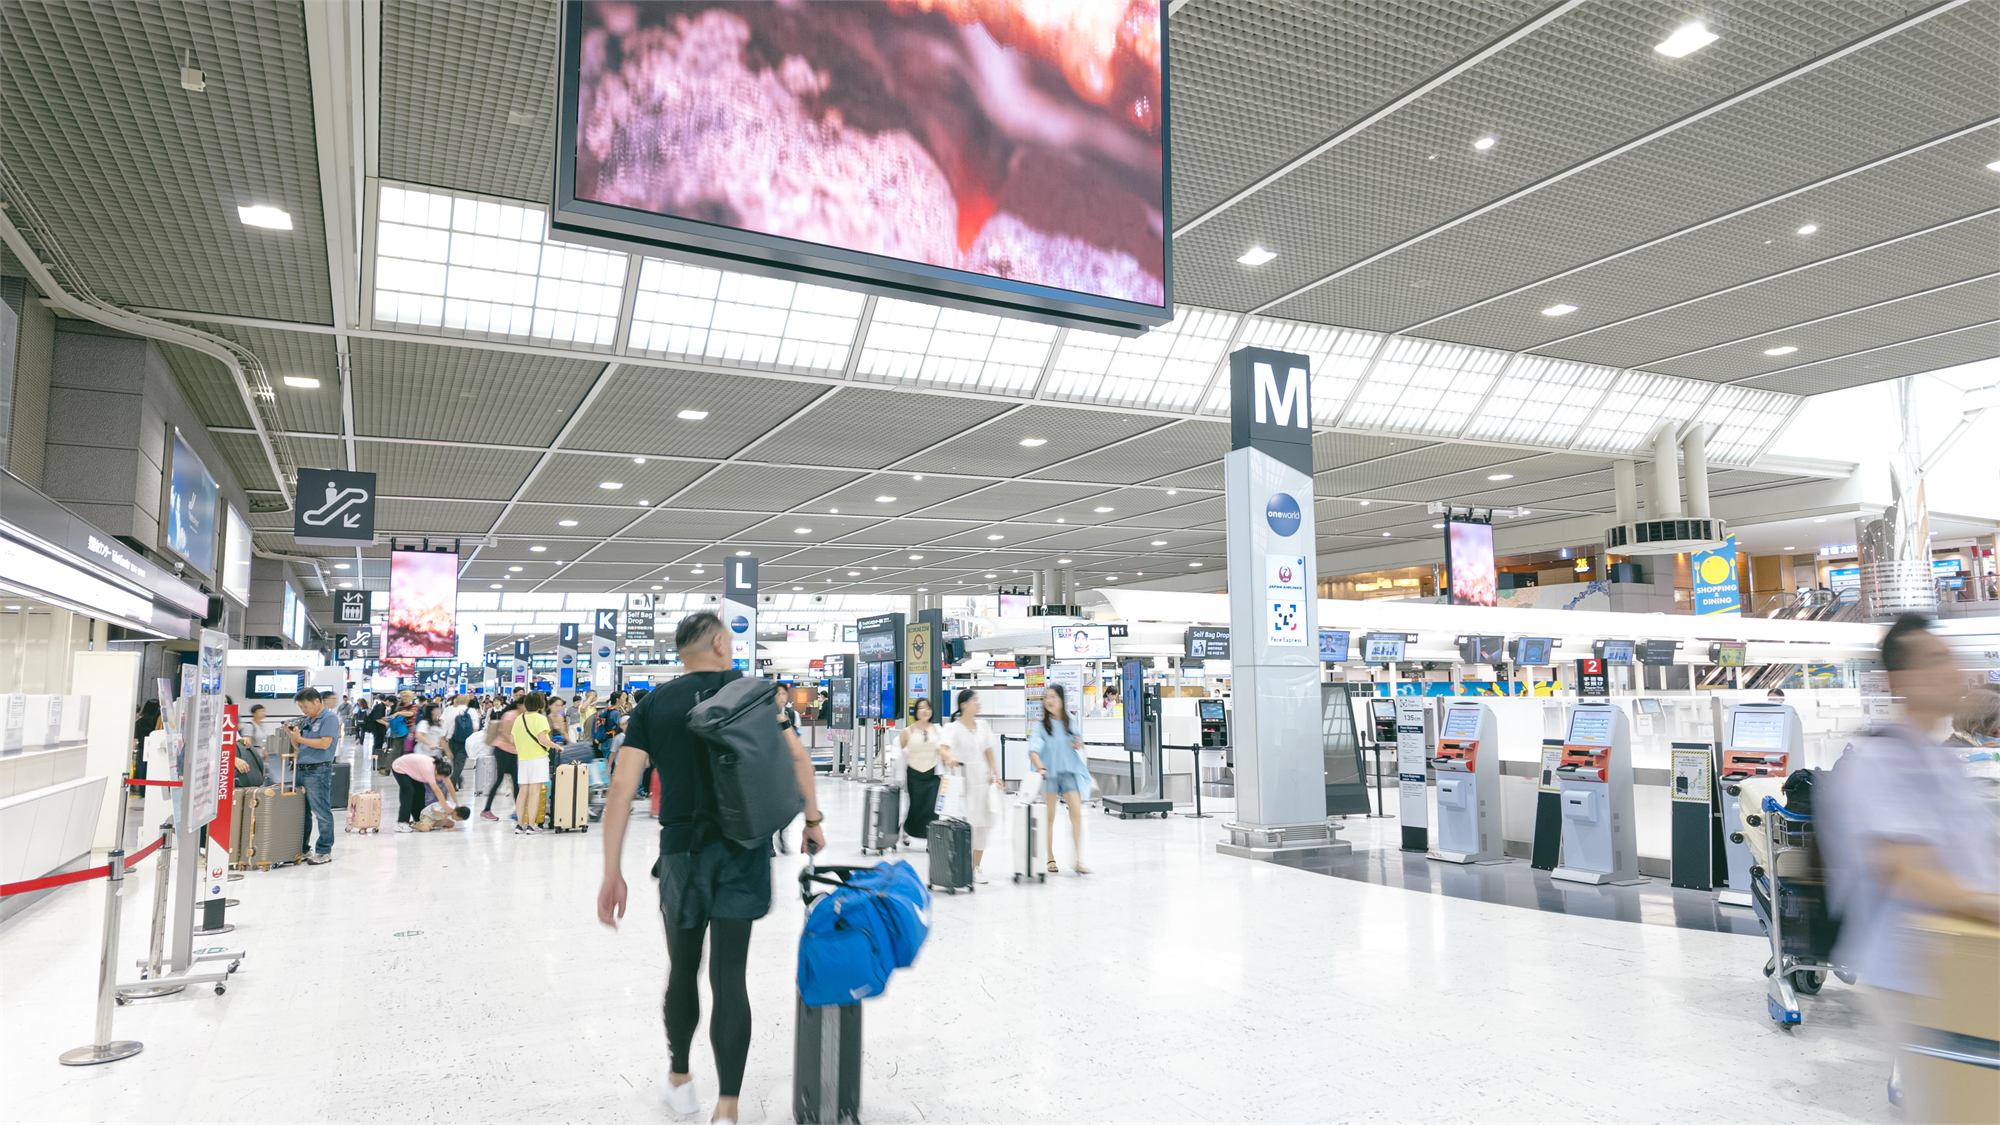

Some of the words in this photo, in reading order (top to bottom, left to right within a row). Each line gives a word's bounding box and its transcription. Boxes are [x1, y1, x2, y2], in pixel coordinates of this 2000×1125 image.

[1254, 362, 1308, 429] M
[1268, 511, 1300, 520] oneworld
[736, 563, 751, 589] L
[1697, 584, 1737, 594] SHOPPING
[641, 611, 653, 619] Bag
[599, 612, 614, 630] K
[565, 625, 573, 641] J
[1111, 627, 1125, 635] M1
[487, 653, 497, 663] H
[449, 667, 457, 676] D
[461, 663, 468, 672] E
[1588, 660, 1598, 673] 2
[257, 684, 276, 692] 300
[222, 713, 235, 745] 入口
[218, 750, 230, 800] ENTRANCE
